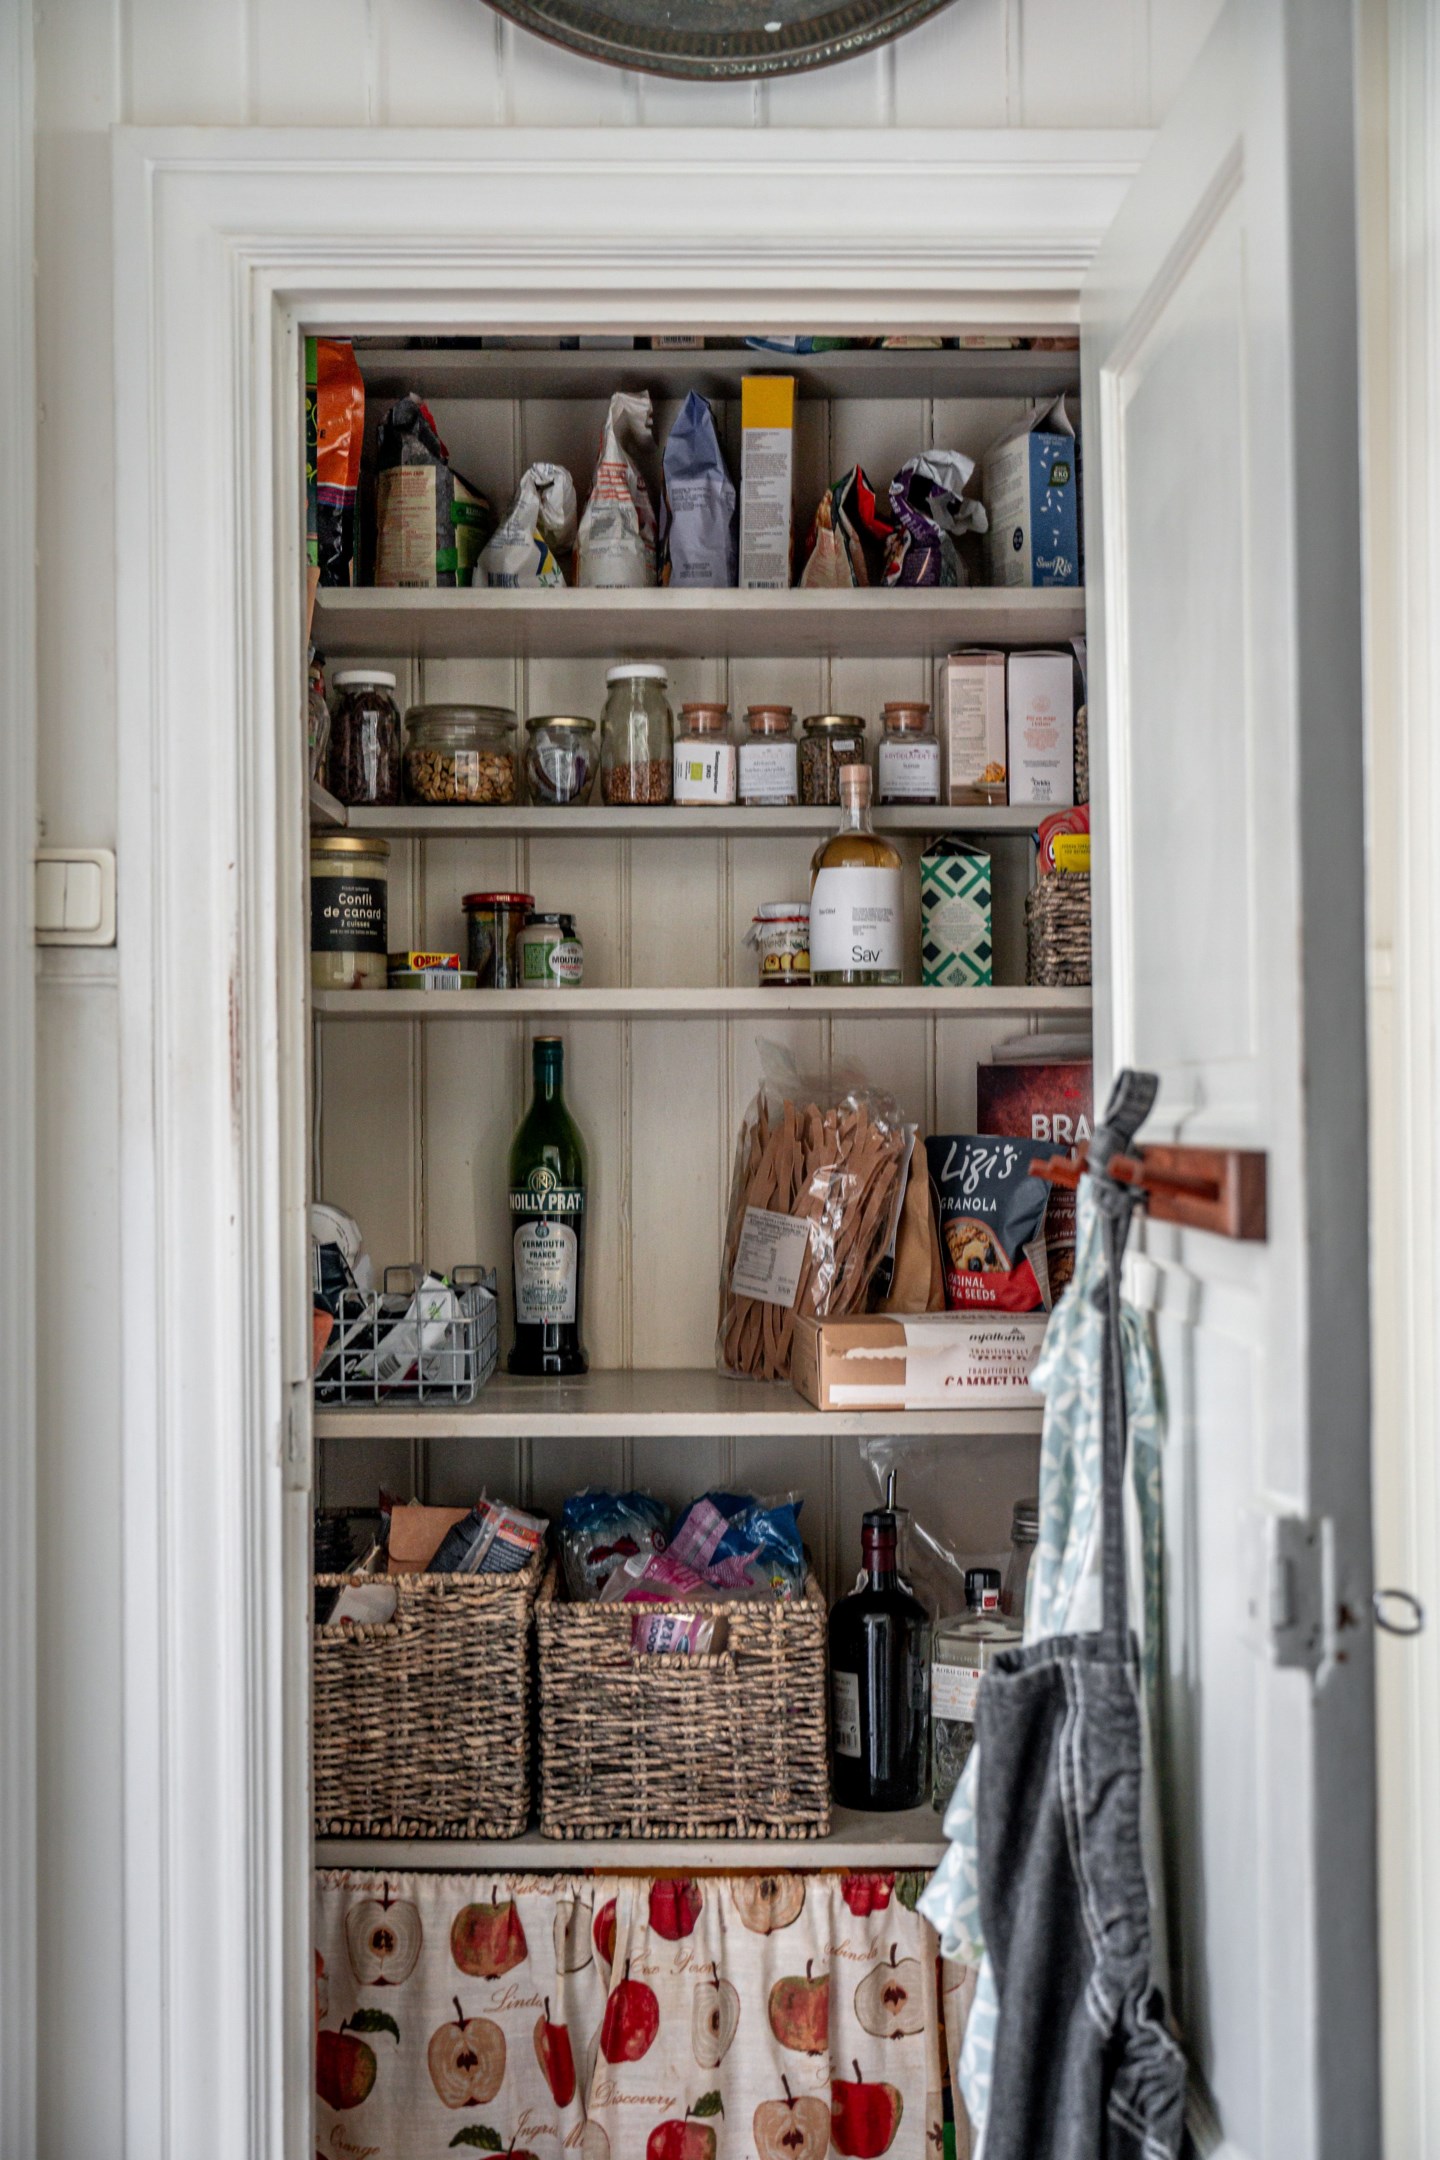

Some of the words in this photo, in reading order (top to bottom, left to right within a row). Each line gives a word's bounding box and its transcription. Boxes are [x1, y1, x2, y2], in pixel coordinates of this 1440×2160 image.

[338, 892, 373, 906] Confit
[323, 906, 340, 918] de
[344, 908, 381, 920] canard
[851, 944, 881, 963] Sav
[1031, 1113, 1092, 1144] BRA
[510, 1193, 548, 1211] NOILLY
[549, 1193, 581, 1211] PRAT
[941, 1197, 997, 1212] GRANOLA
[521, 1239, 565, 1249] VERMOUTH
[529, 1251, 557, 1259] FRANCE
[965, 1288, 996, 1301] SEEDS
[483, 1983, 543, 2013] Linda
[589, 2080, 677, 2112] Discovery
